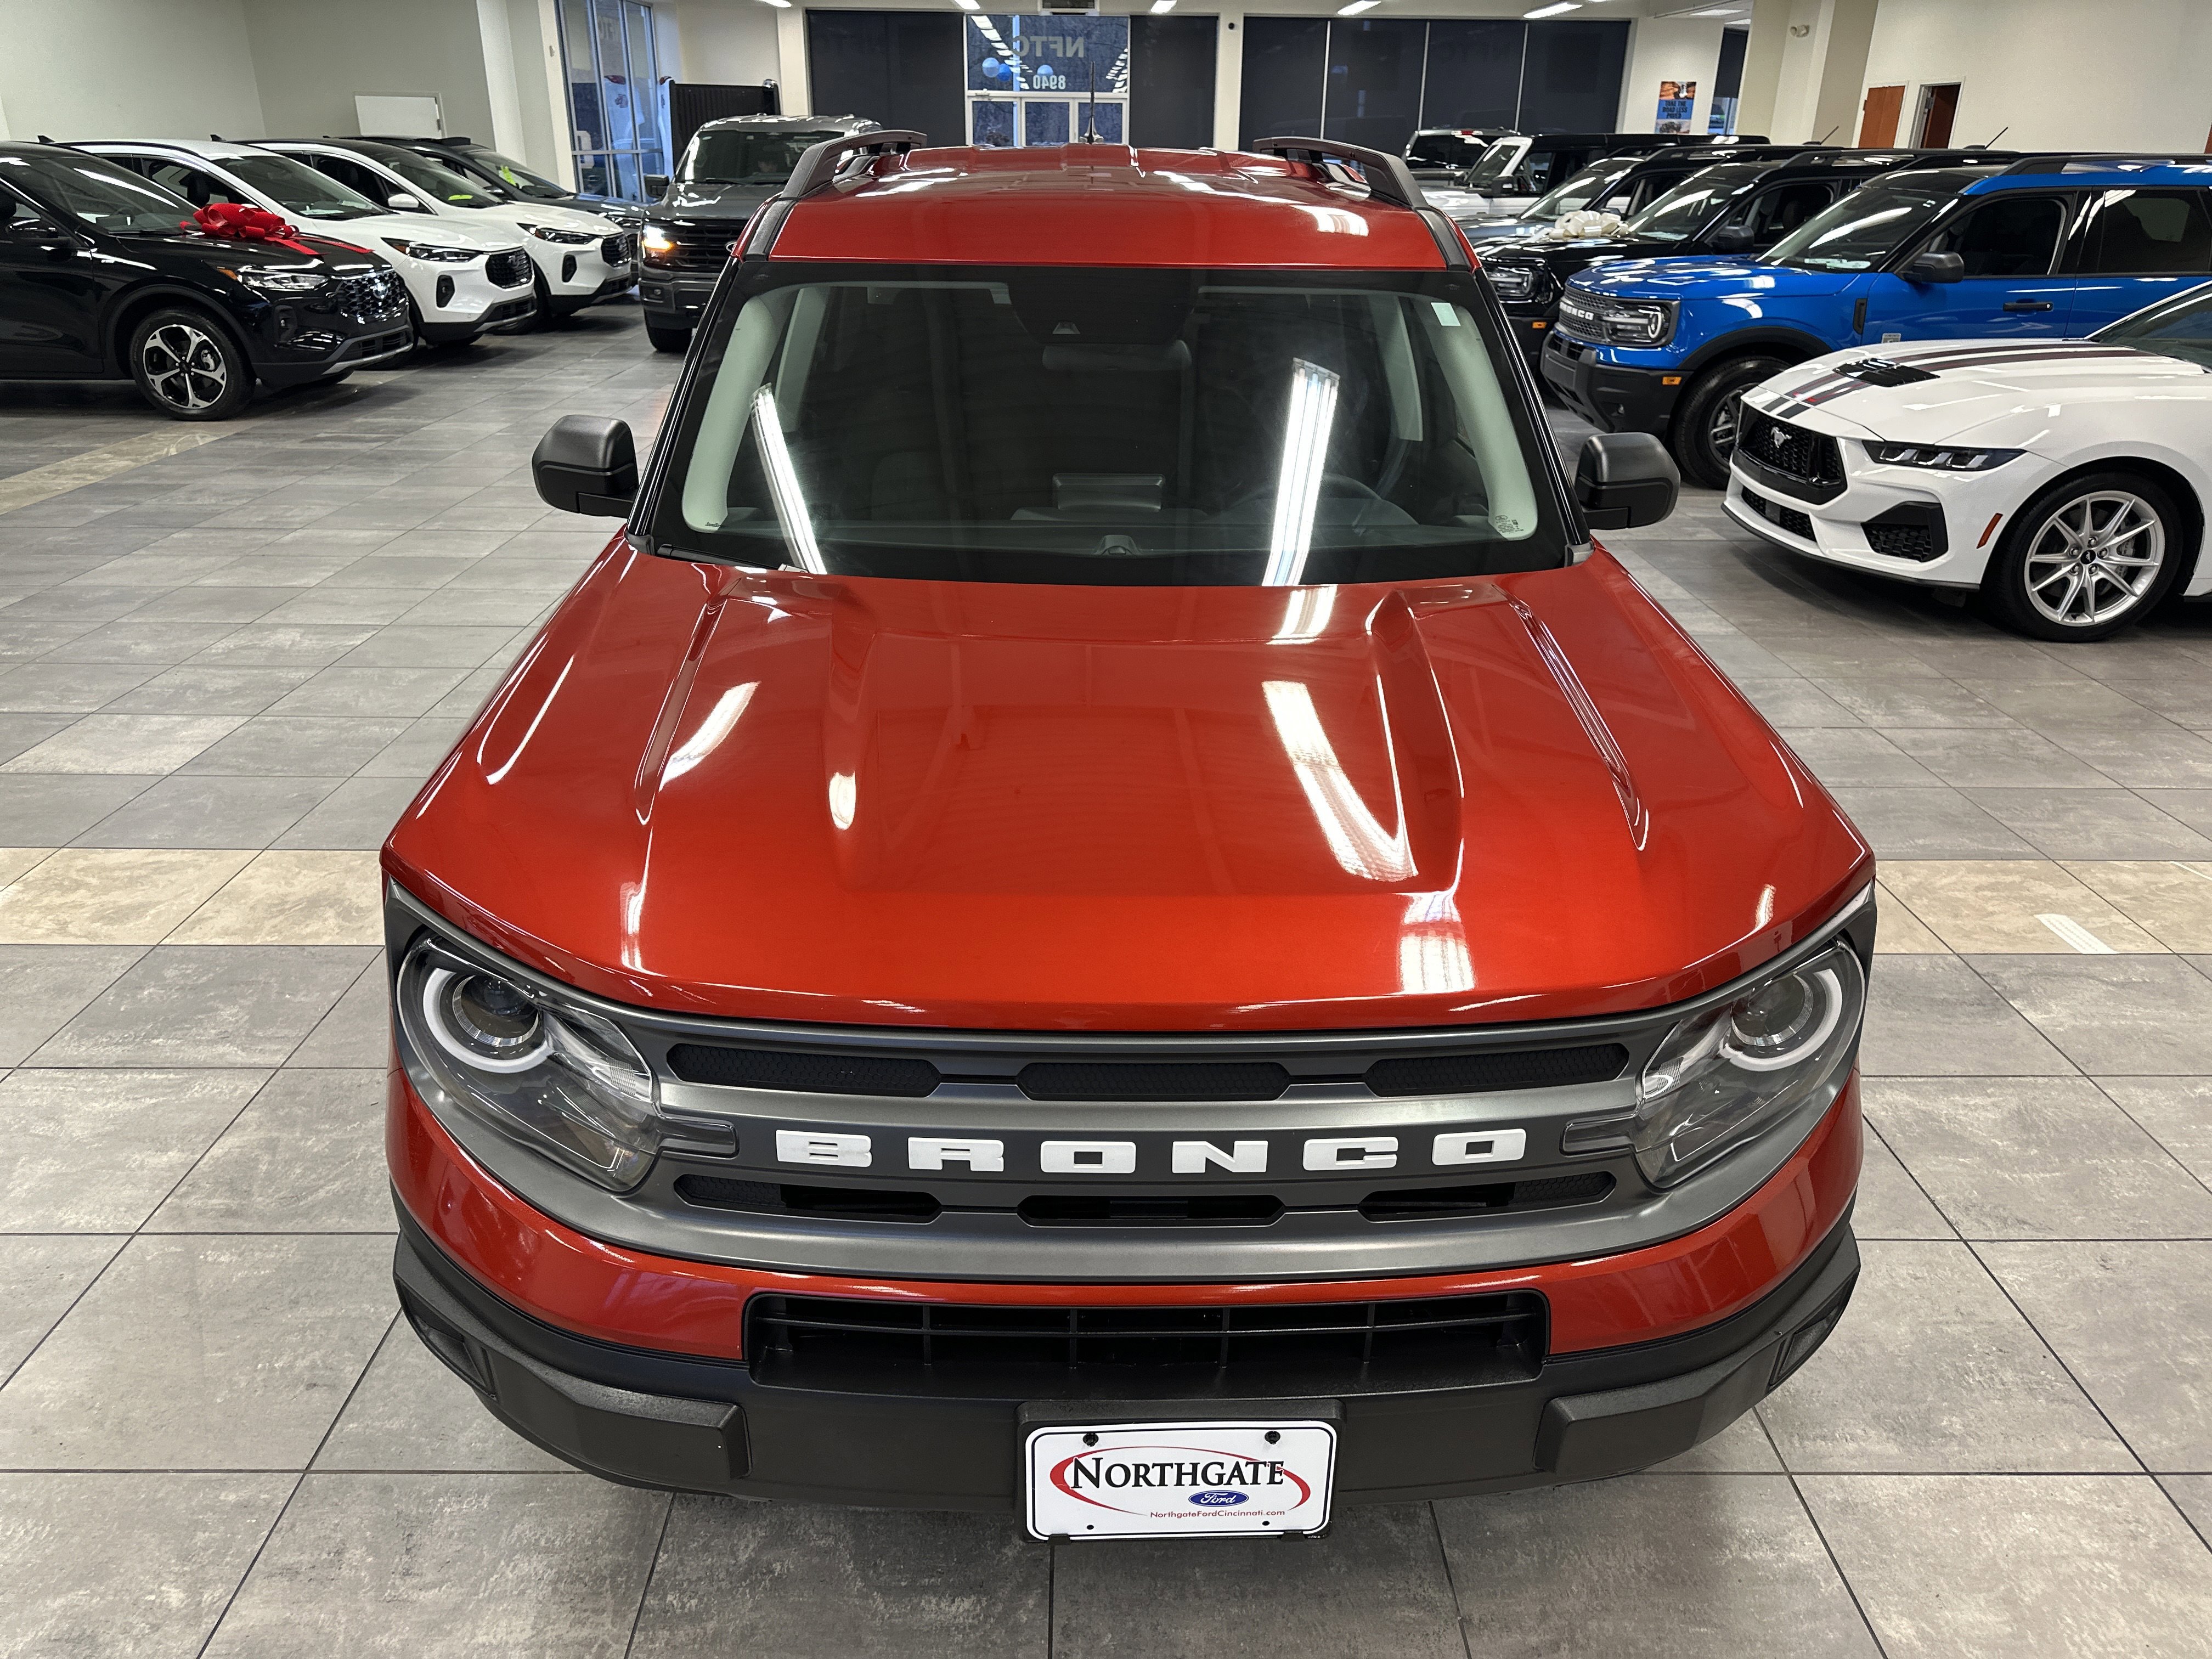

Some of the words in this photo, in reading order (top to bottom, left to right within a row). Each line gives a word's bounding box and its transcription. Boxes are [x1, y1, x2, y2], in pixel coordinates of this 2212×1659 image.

[776, 1127, 1527, 1173] BRONCO
[1200, 1492, 1237, 1504] Ford
[1150, 1510, 1285, 1519] NorthgateFordCincinnati.com
